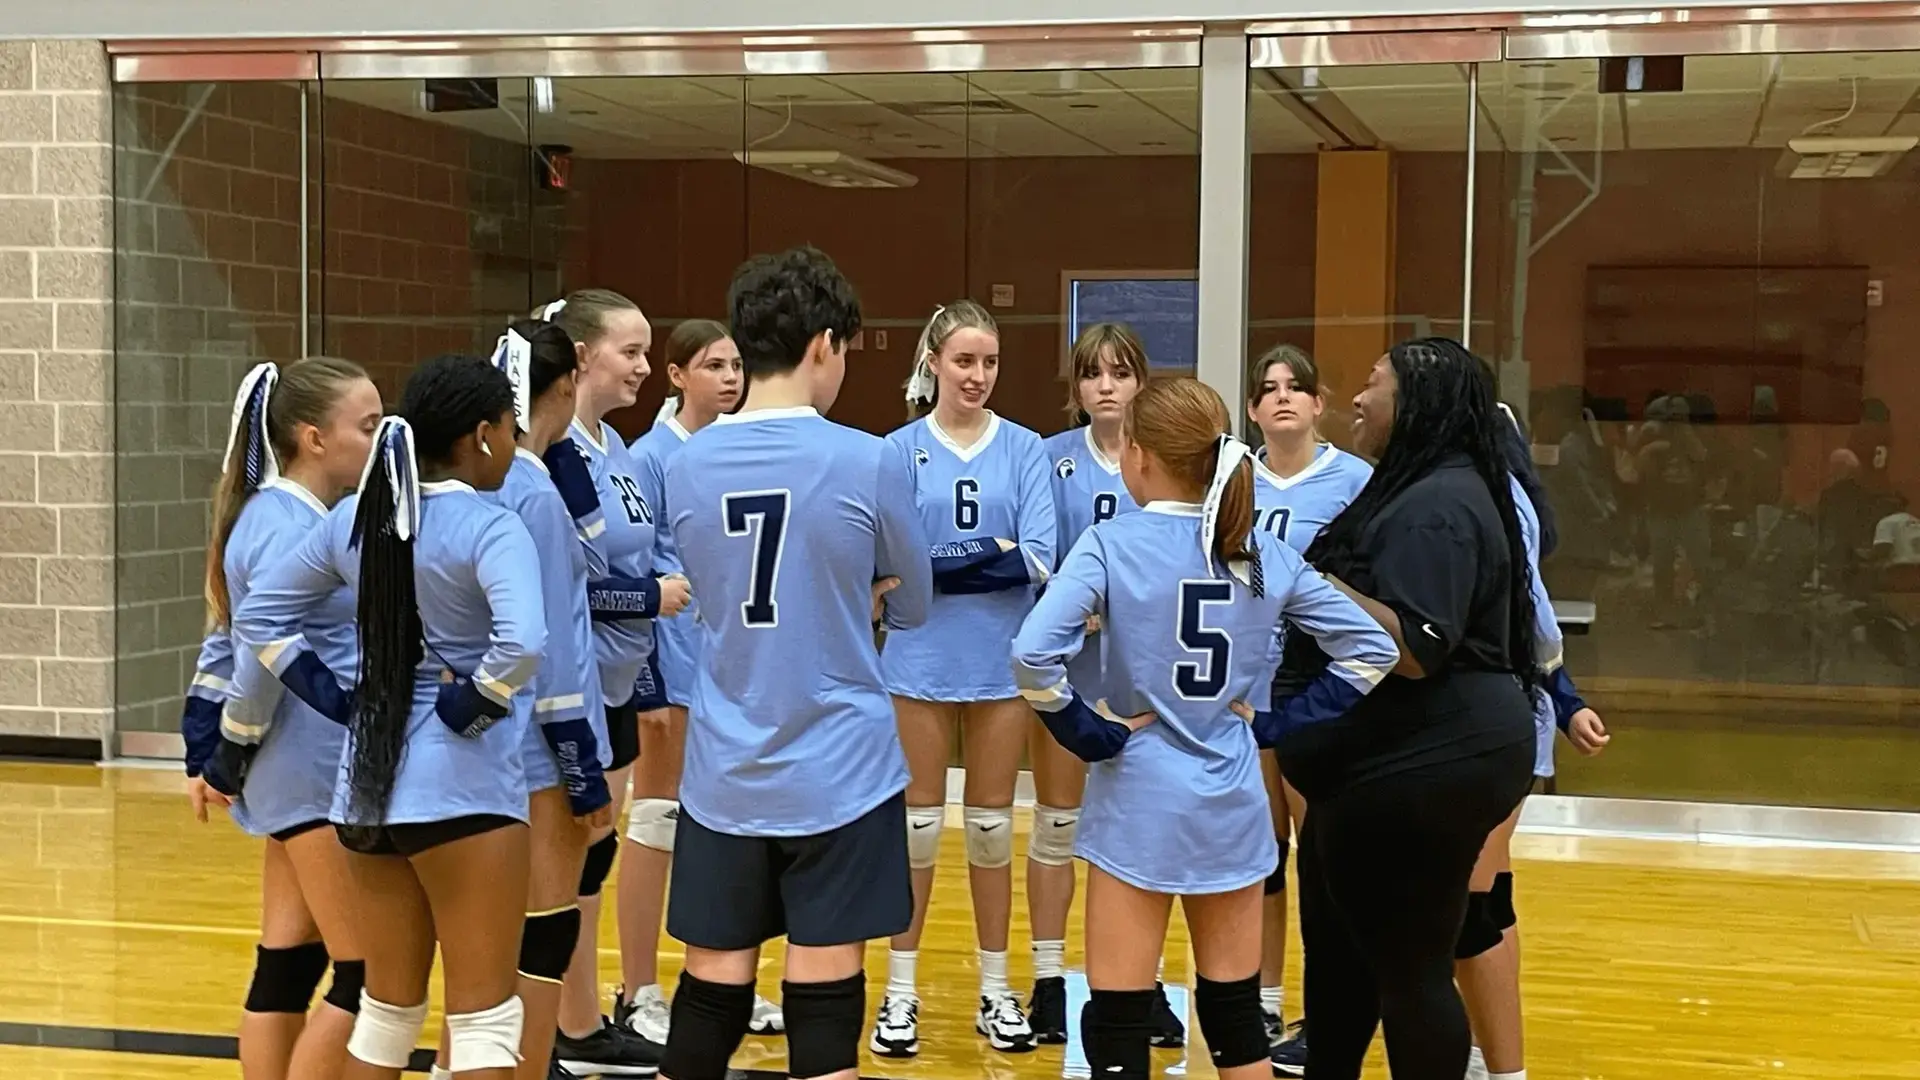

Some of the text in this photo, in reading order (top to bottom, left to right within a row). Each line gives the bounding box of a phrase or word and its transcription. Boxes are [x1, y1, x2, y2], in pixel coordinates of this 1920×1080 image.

[608, 473, 654, 526] 26
[953, 477, 981, 532] 6
[721, 488, 791, 628] 7
[1172, 579, 1234, 700] 5
